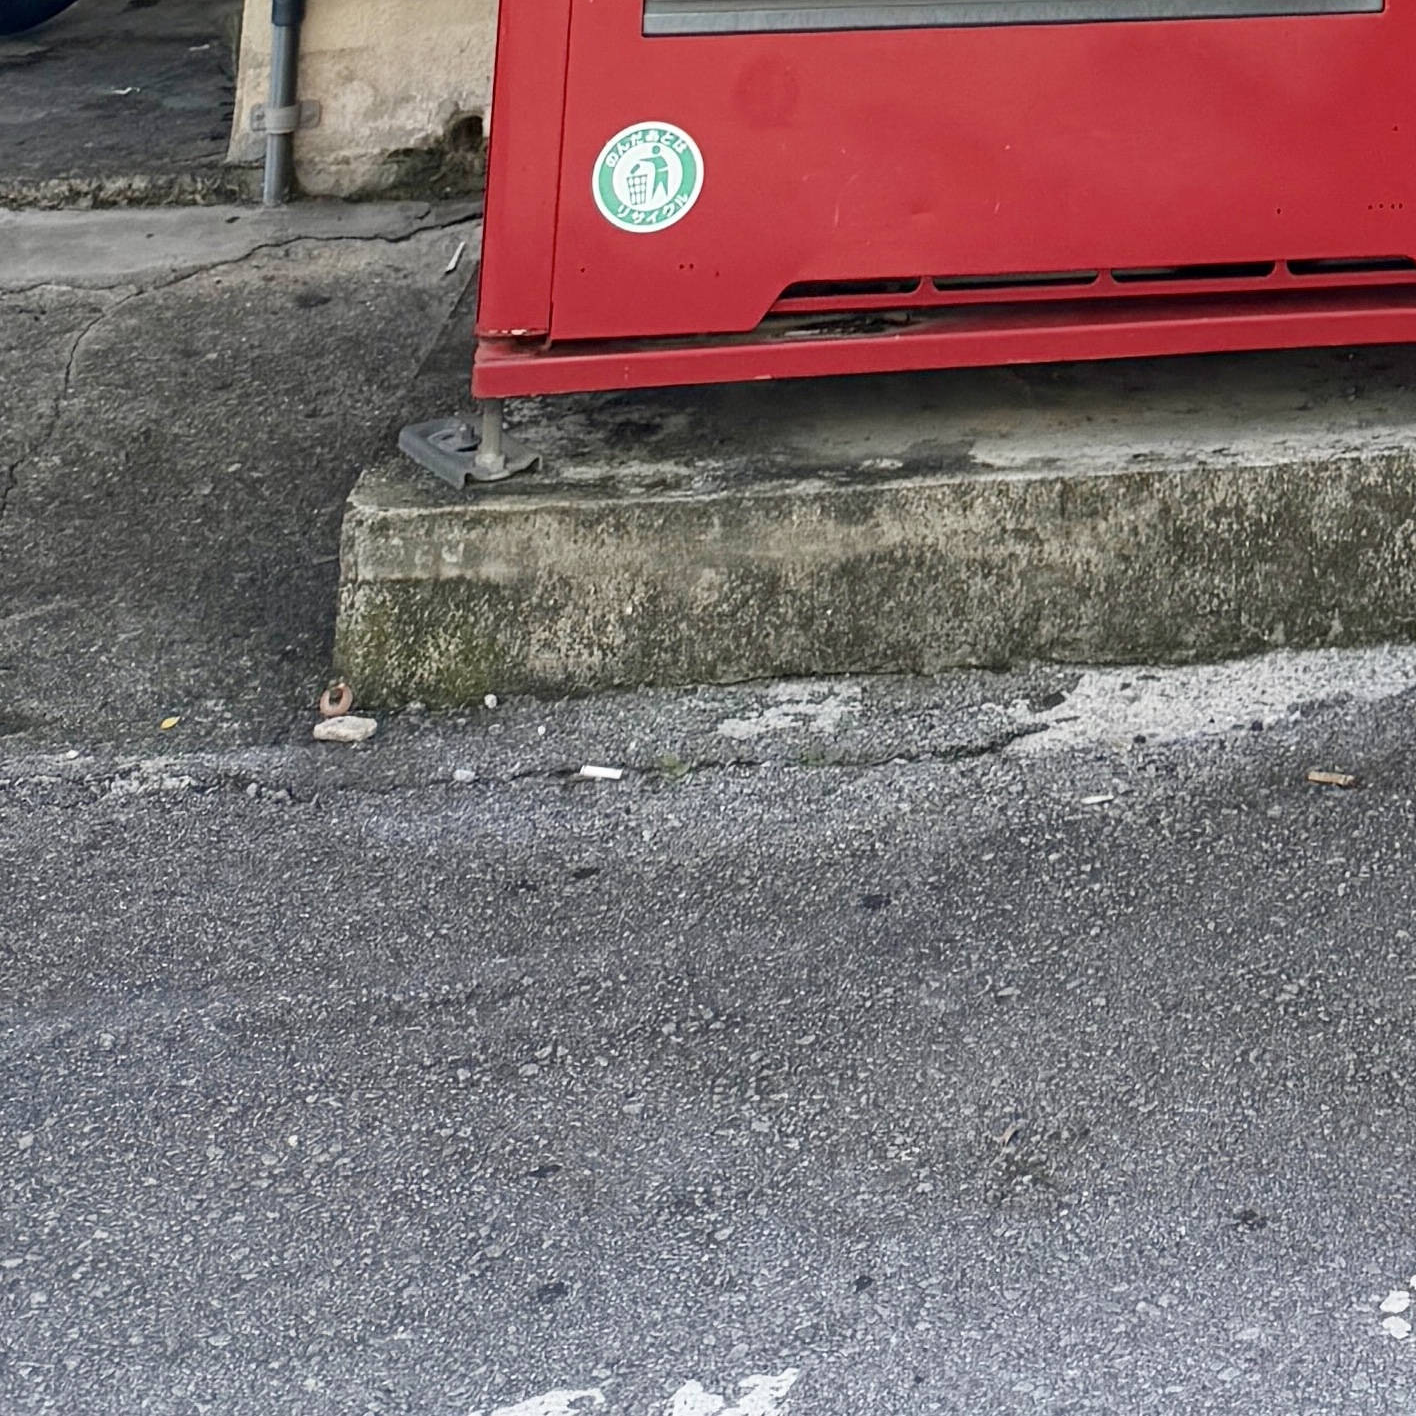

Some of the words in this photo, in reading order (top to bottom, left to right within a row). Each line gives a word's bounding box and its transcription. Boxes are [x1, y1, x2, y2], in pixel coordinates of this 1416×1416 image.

[606, 130, 688, 168] のんだあとは
[618, 193, 688, 224] リサイクル
